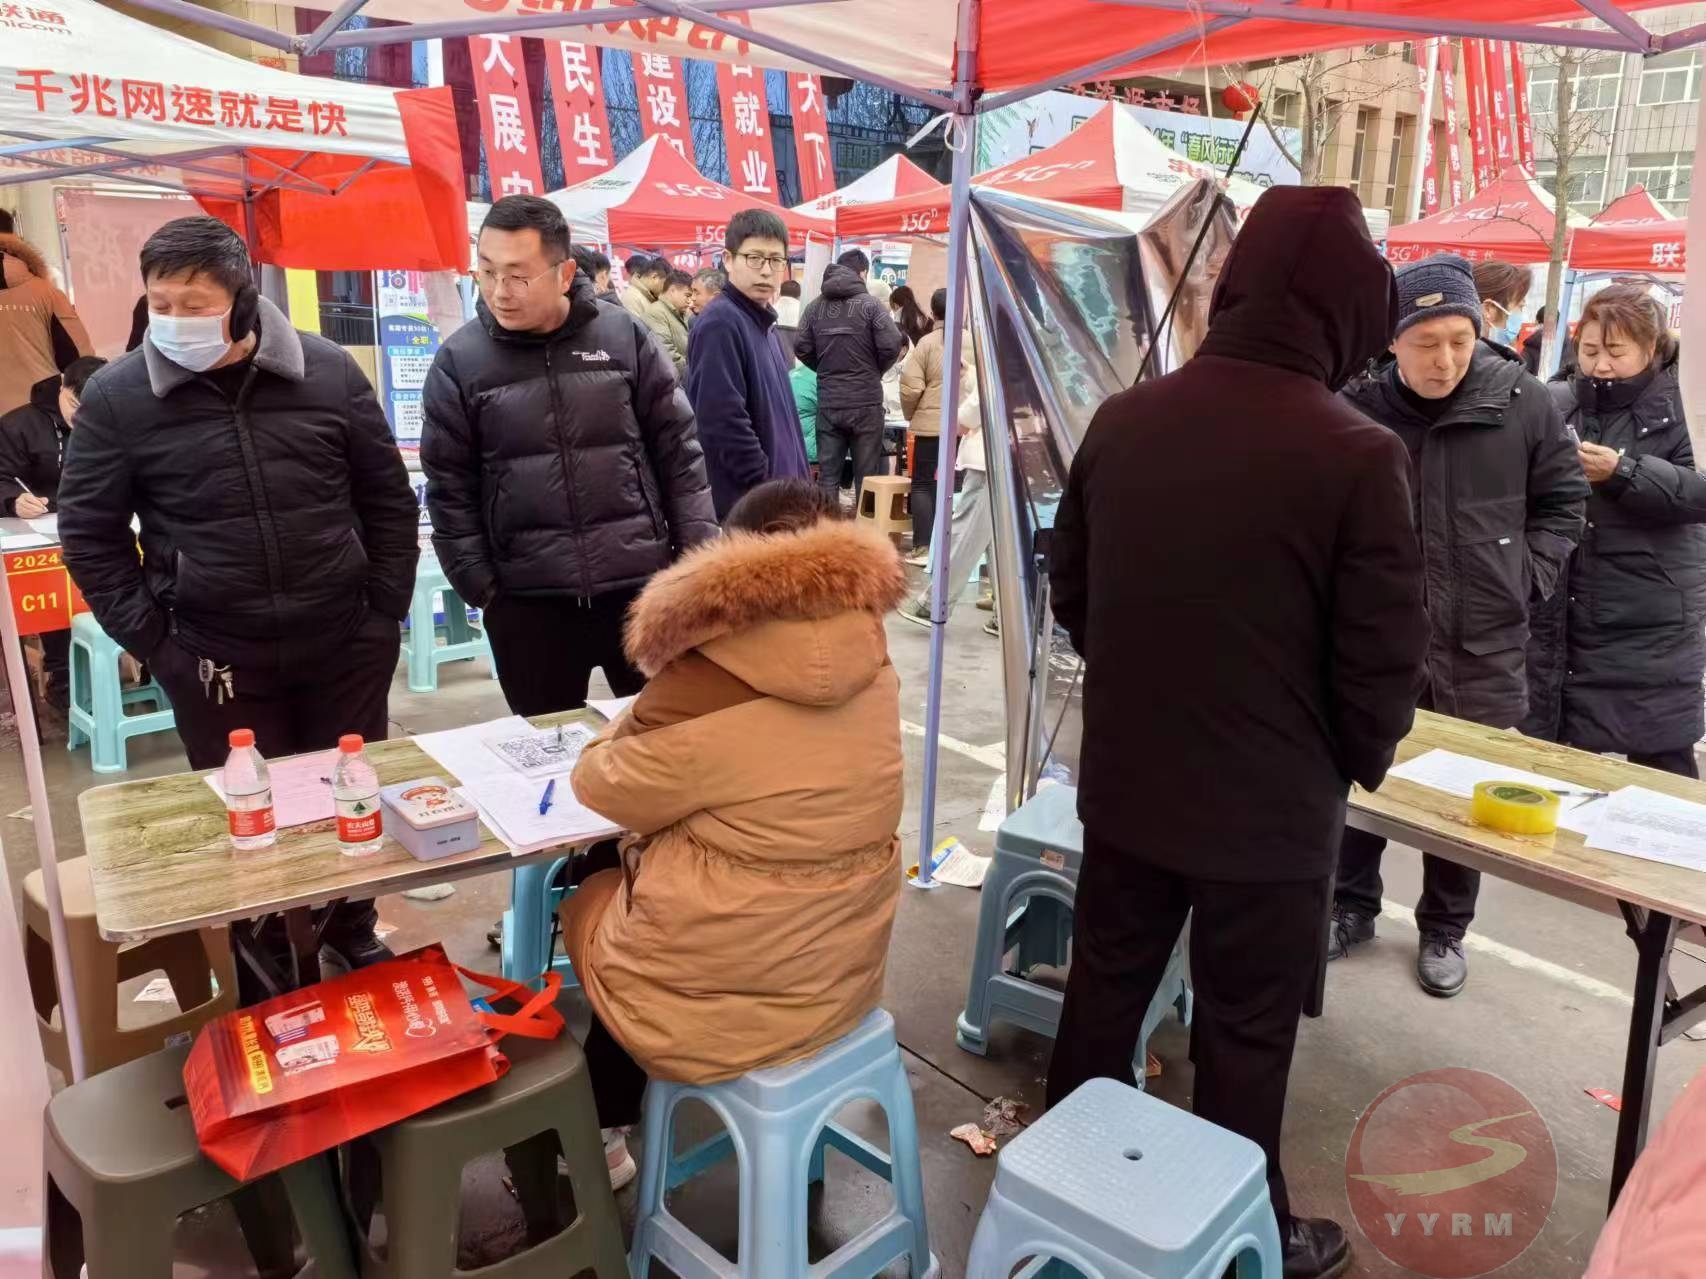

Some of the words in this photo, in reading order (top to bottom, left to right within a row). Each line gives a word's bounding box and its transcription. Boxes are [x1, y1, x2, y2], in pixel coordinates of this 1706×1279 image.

[15, 69, 348, 137] 千兆网速就是快
[559, 40, 608, 167] 民生
[641, 52, 685, 156] 建设
[1650, 242, 1685, 268] 联
[13, 552, 59, 569] 2024
[22, 591, 58, 613] C11
